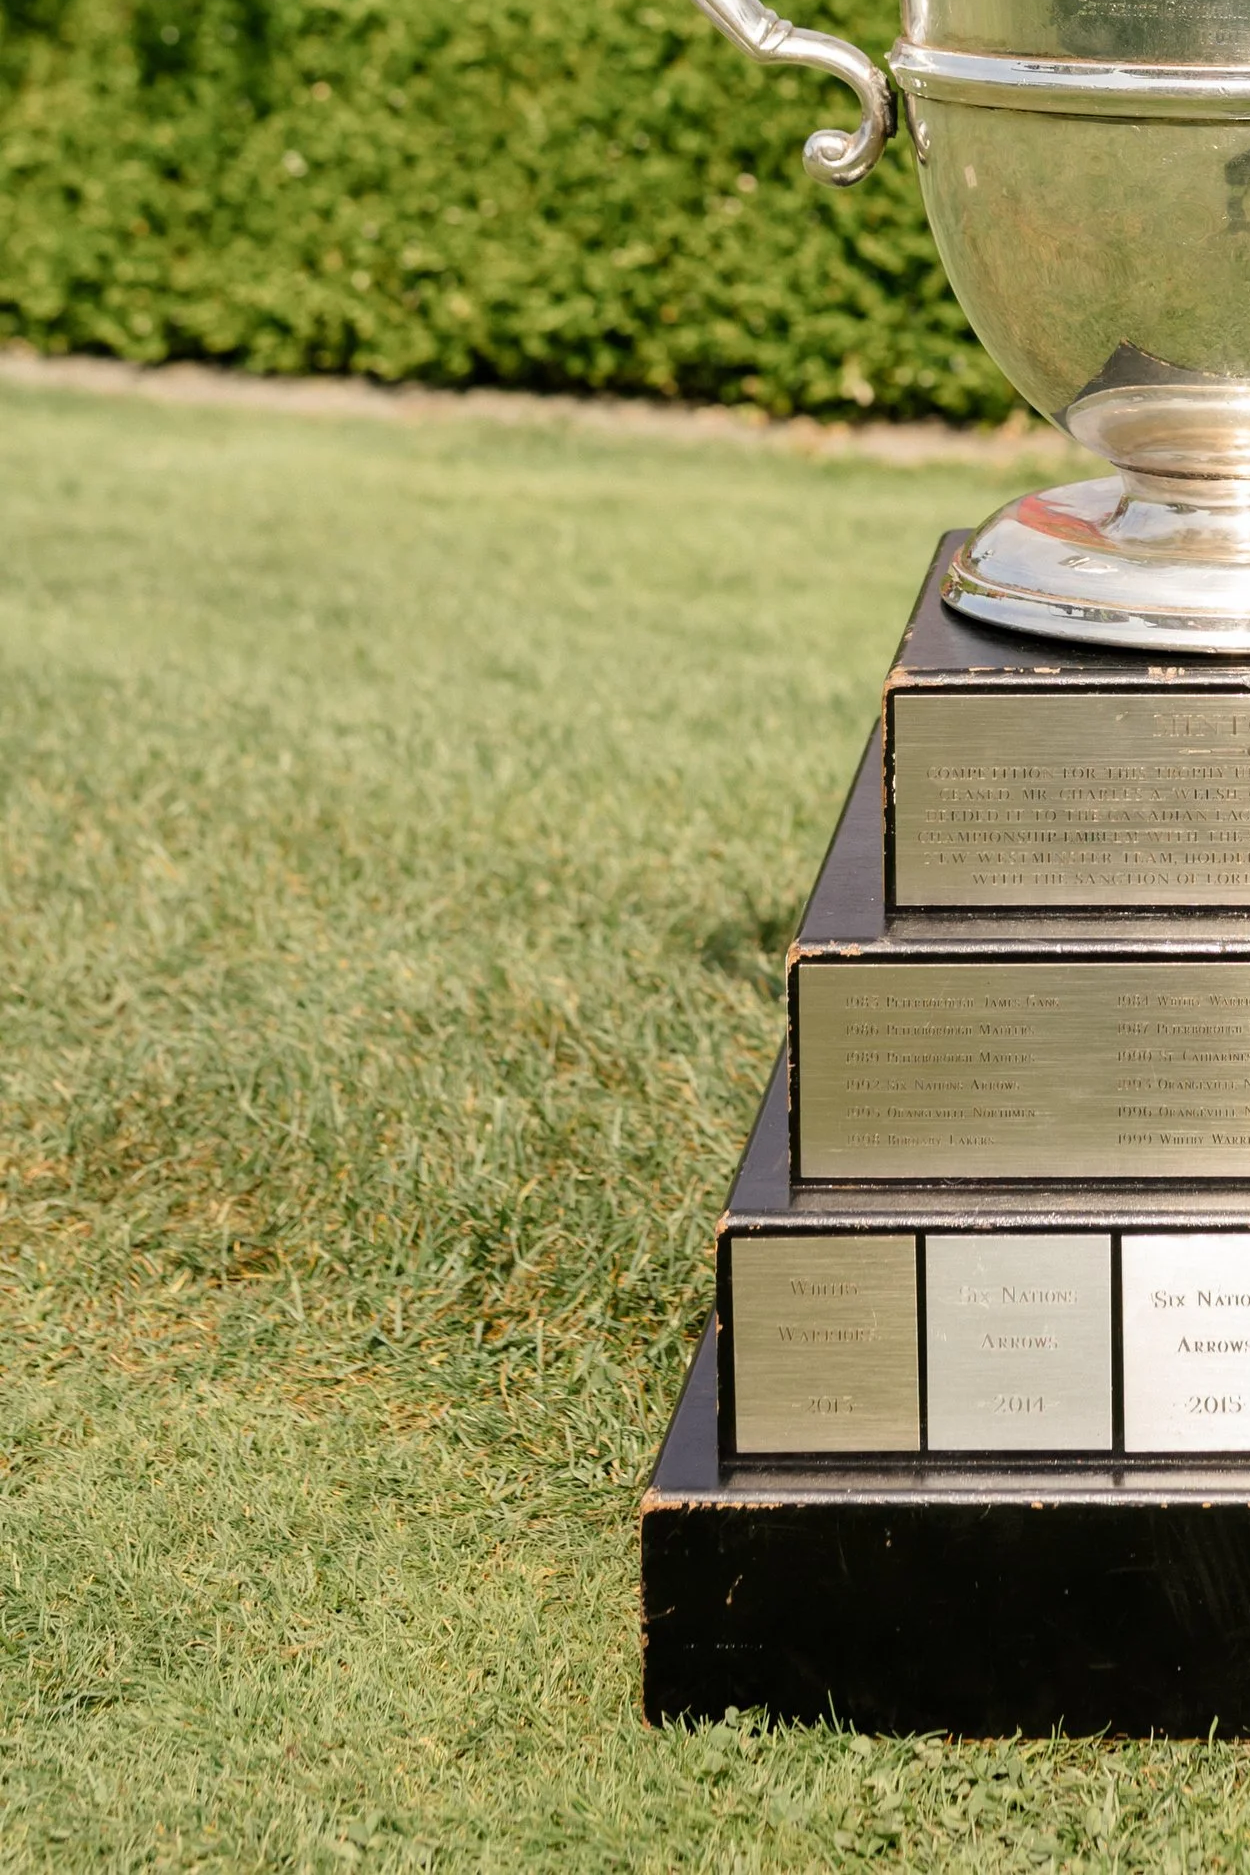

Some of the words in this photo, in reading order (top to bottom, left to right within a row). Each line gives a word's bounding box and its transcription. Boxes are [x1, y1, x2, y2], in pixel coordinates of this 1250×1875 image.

[926, 766, 1054, 780] COMPETITION
[1063, 766, 1096, 780] FOR
[1103, 766, 1146, 780] THIS
[1157, 766, 1225, 780] TROPHY
[1059, 788, 1143, 801] CHARLES
[1006, 810, 1025, 822] IT
[1036, 810, 1057, 822] TO
[1067, 810, 1099, 822] THE
[1108, 810, 1206, 822] CANADIAN
[918, 830, 1057, 843] CHAMPIONSHIP
[1064, 830, 1140, 843] EMBLEM
[1148, 830, 1198, 843] WITH
[1209, 830, 1243, 843] THE
[978, 852, 1111, 864] WESTMINSTER
[973, 873, 1025, 885] WITH
[1035, 873, 1068, 885] THE
[1075, 873, 1168, 885] SANCTION
[1177, 873, 1198, 885] OF
